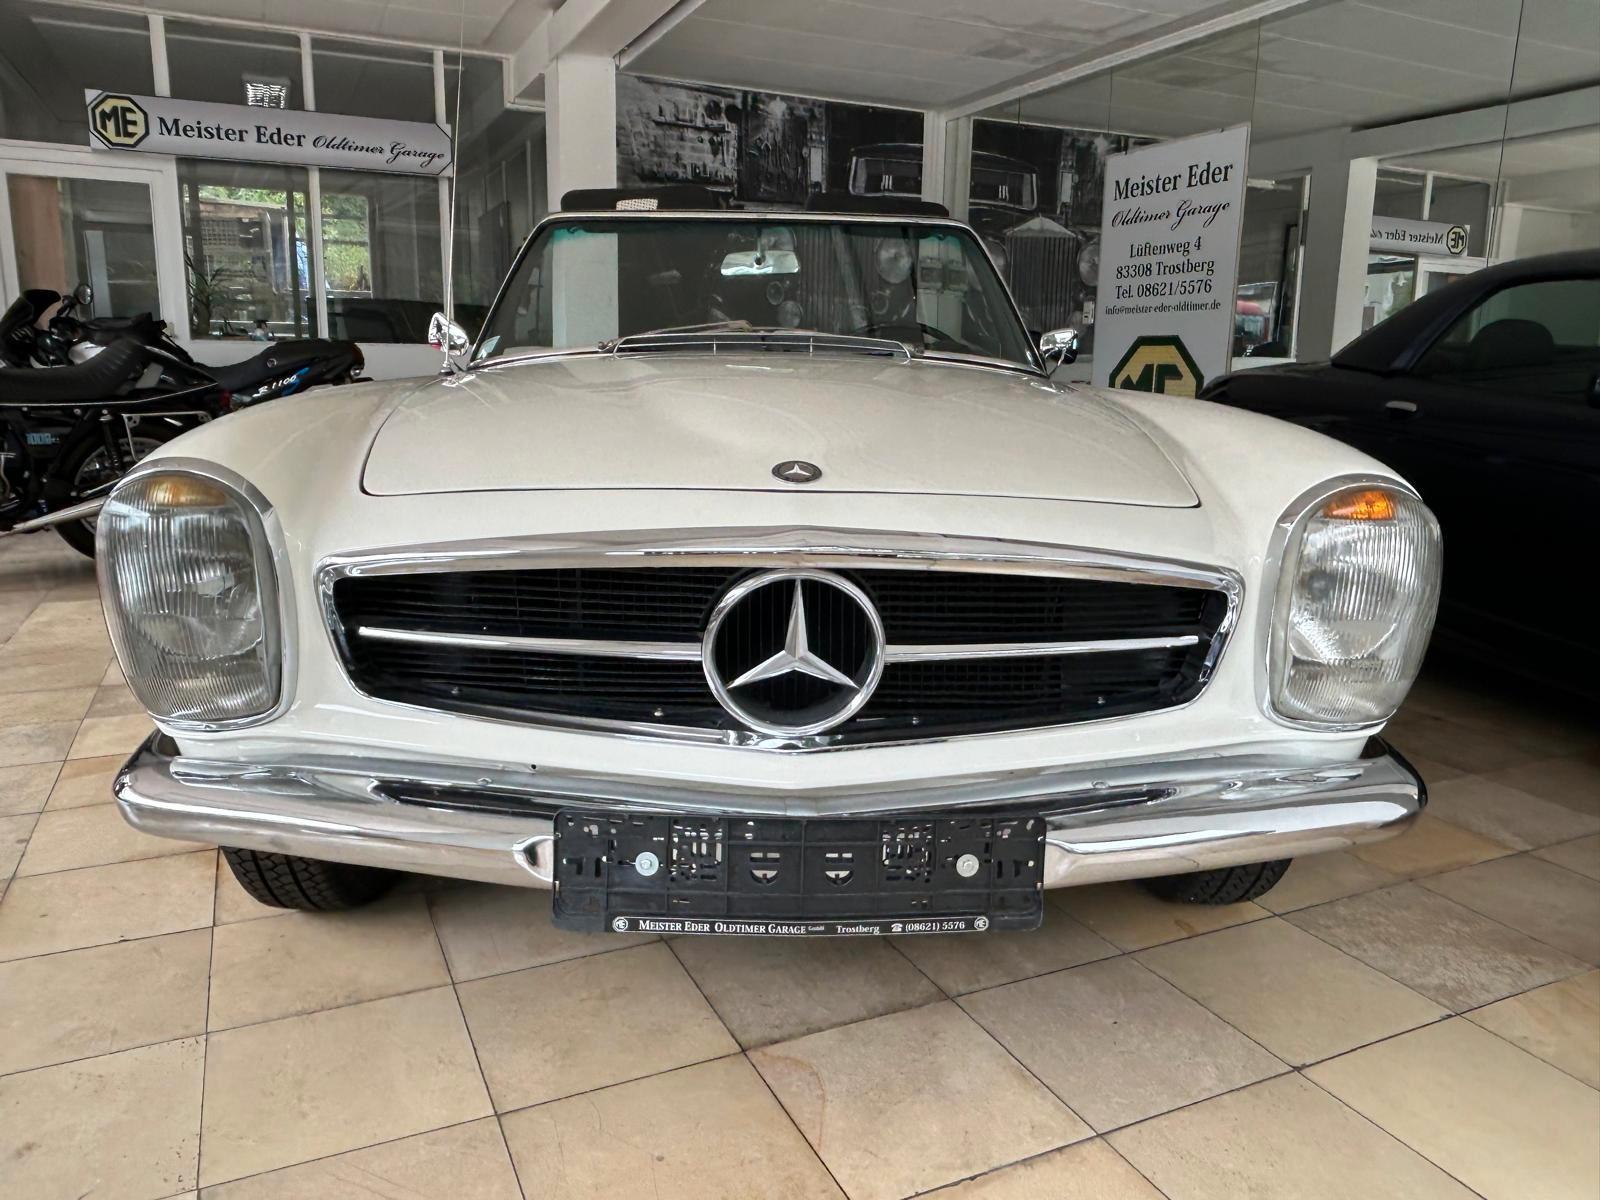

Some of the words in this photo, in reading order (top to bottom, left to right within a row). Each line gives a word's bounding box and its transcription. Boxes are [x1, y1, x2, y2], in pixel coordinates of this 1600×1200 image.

[100, 106, 137, 138] ME
[157, 116, 248, 142] Meister
[255, 125, 306, 147] Eder
[312, 135, 385, 154] Oldtimer
[386, 141, 445, 168] Garage
[1113, 174, 1182, 201] Meister
[1186, 161, 1233, 188] Eder
[1111, 207, 1170, 228] Oldtimer
[1170, 199, 1230, 231] Garage
[1130, 242, 1190, 258] Lüftenweg
[1193, 236, 1202, 251] 4
[1116, 263, 1153, 280] 83308
[1155, 259, 1215, 276] Trostberg
[1116, 285, 1134, 299] Tel.
[1136, 279, 1213, 298] 08621/5576
[638, 919, 682, 931] MEISTER
[684, 921, 710, 931] EDER
[714, 922, 766, 933] OLDTIMER
[768, 923, 806, 934] GARAGE
[836, 924, 880, 935] Trostberg
[905, 922, 940, 932] (08621)
[942, 921, 965, 930] 5576
